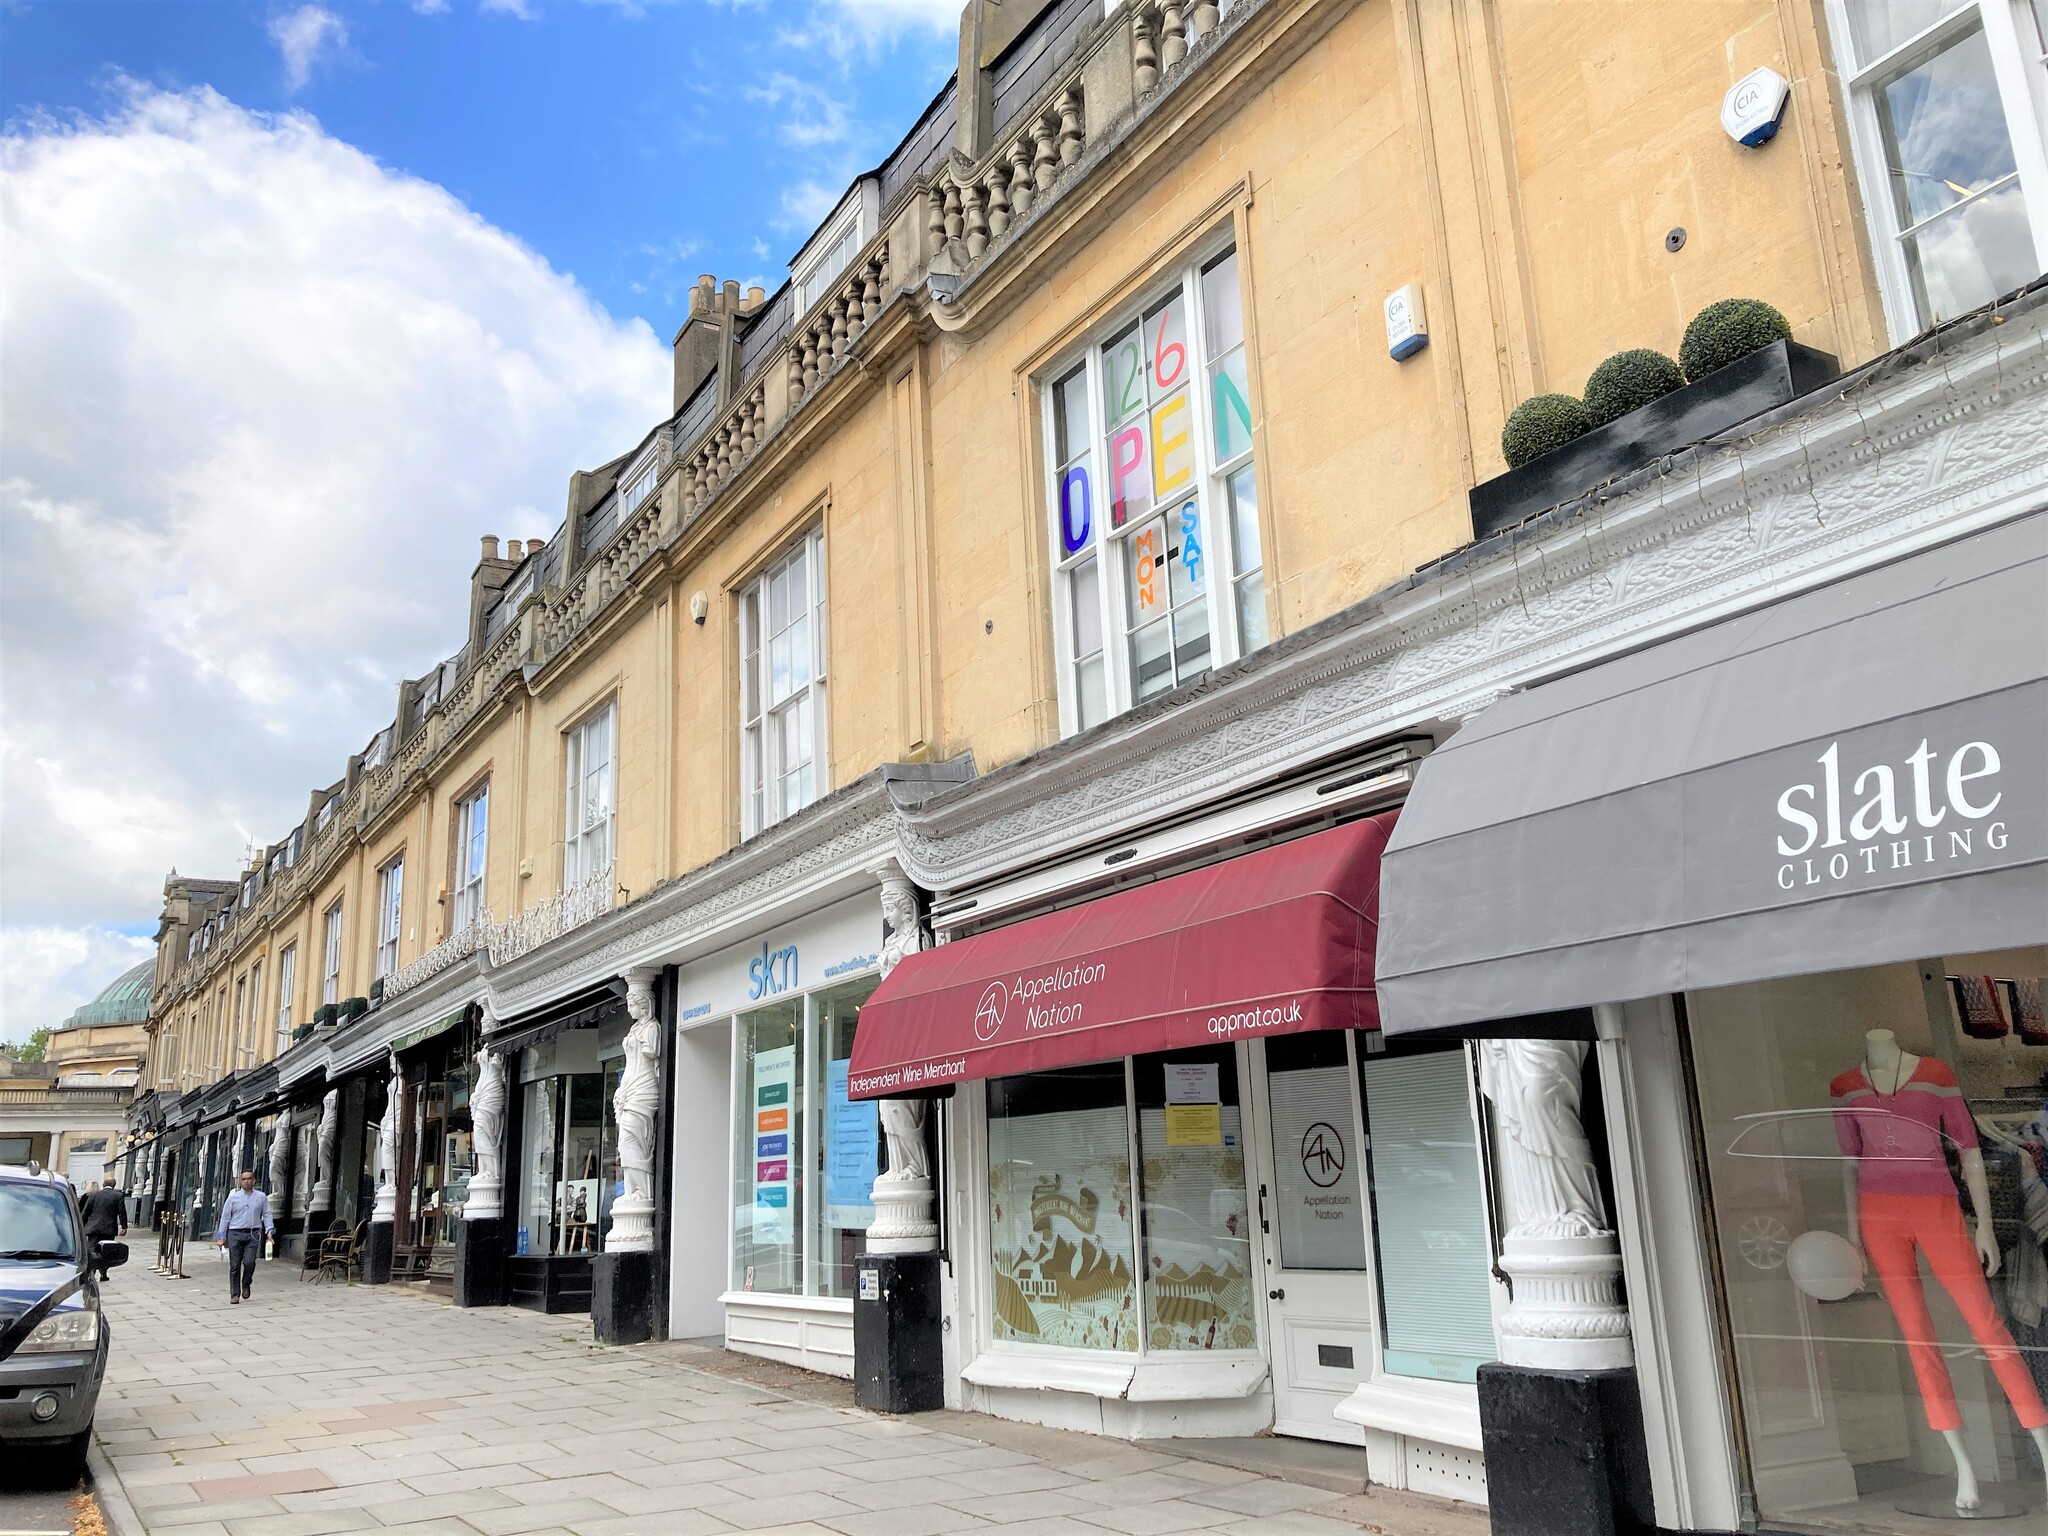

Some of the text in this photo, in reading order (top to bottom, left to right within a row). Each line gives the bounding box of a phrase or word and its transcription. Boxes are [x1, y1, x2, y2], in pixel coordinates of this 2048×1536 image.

[1737, 90, 1759, 110] CIA
[1390, 302, 1404, 316] CIA
[1062, 371, 1252, 553] OPEN
[1776, 737, 2003, 857] slate
[1777, 821, 2010, 890] CLOTHING
[1010, 961, 1106, 1006] Appellation
[1025, 1000, 1083, 1031] Nation
[1207, 998, 1303, 1039] appnat.co.uk
[850, 1069, 900, 1093] Independent
[902, 1065, 921, 1083] Wine
[923, 1057, 966, 1080] Merchant
[1304, 1195, 1351, 1207] Appellation
[1315, 1209, 1344, 1220] Nation
